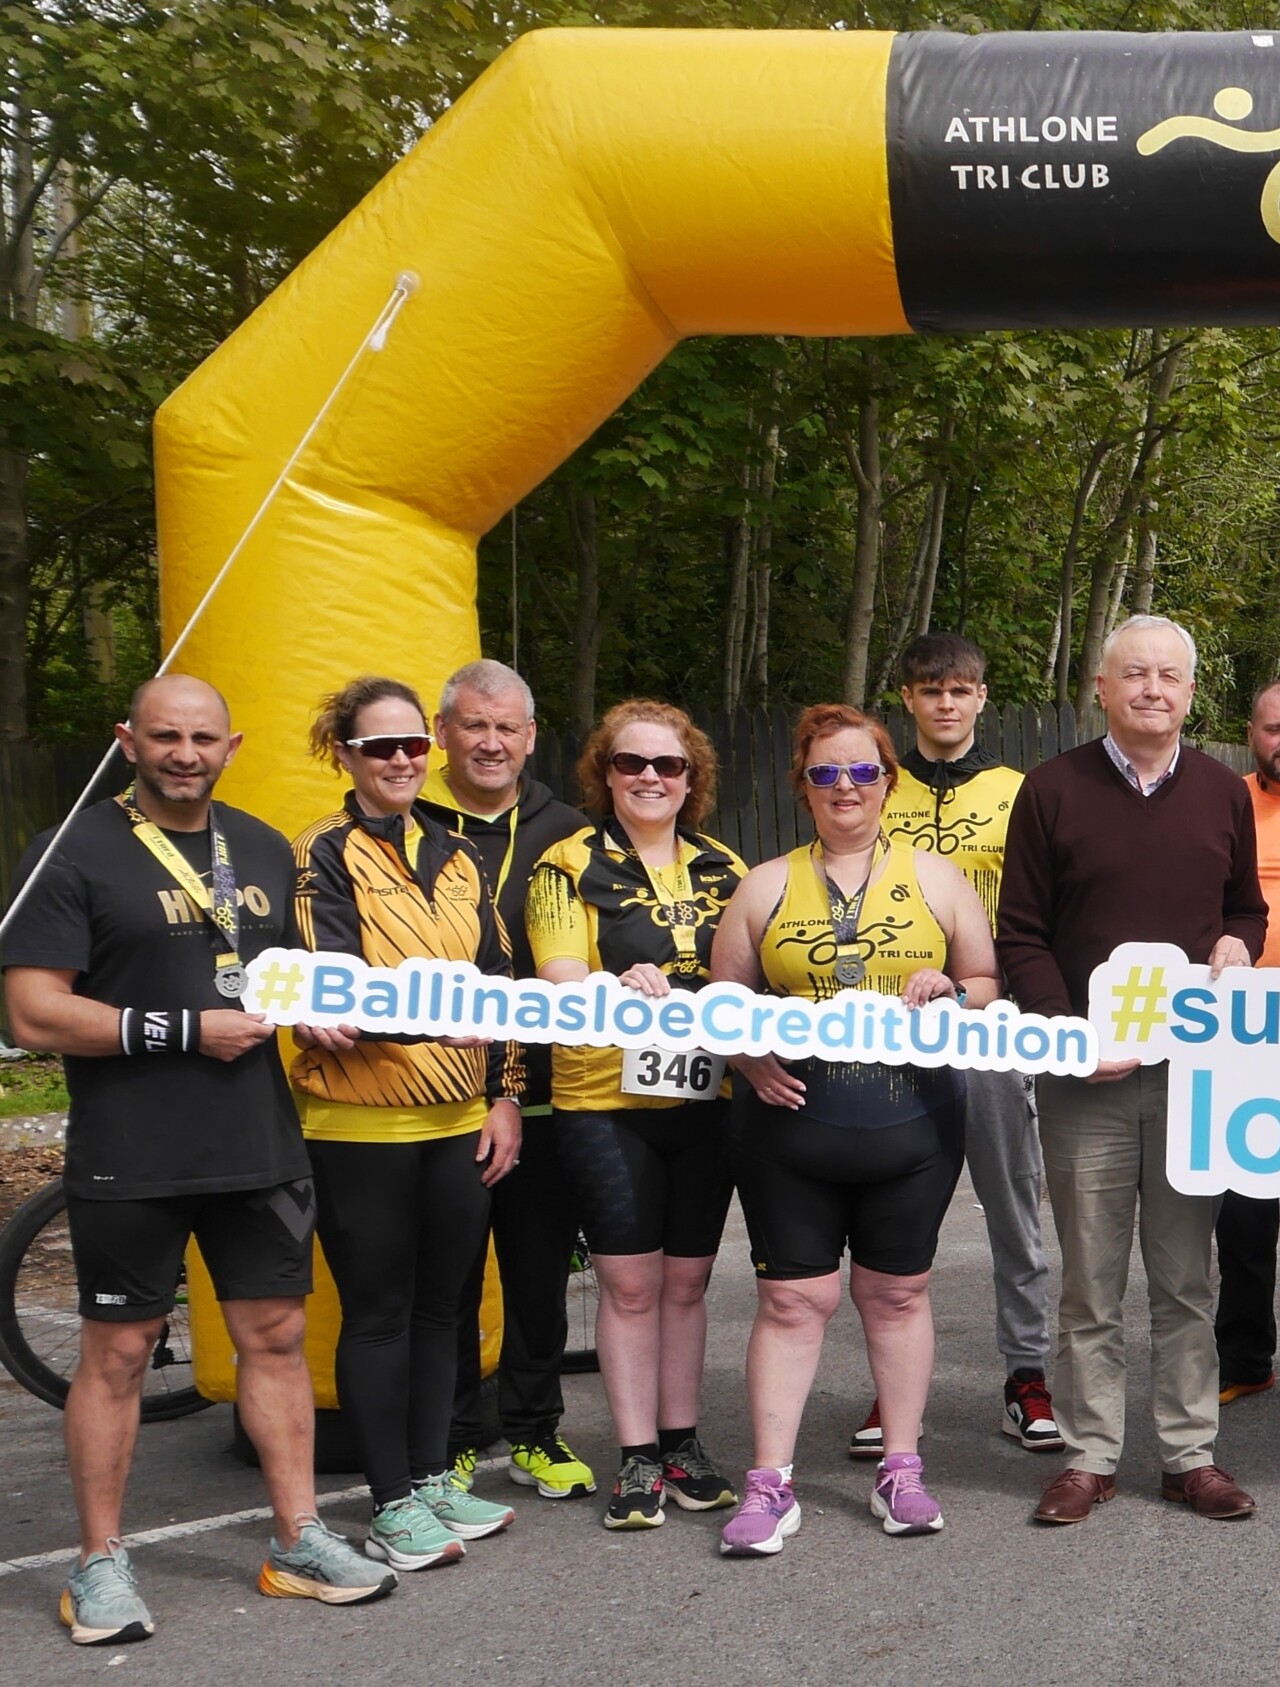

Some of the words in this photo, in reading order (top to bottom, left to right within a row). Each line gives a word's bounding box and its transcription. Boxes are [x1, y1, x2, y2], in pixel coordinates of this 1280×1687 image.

[944, 116, 1118, 143] ATHLONE
[950, 164, 1010, 190] TRI
[1020, 163, 1110, 190] CLUB
[887, 810, 931, 820] ATHLONE
[961, 844, 978, 852] TRI
[980, 845, 1004, 854] CLUB
[878, 950, 900, 959] TRI
[905, 950, 934, 960] CLUB
[637, 1050, 713, 1092] 346
